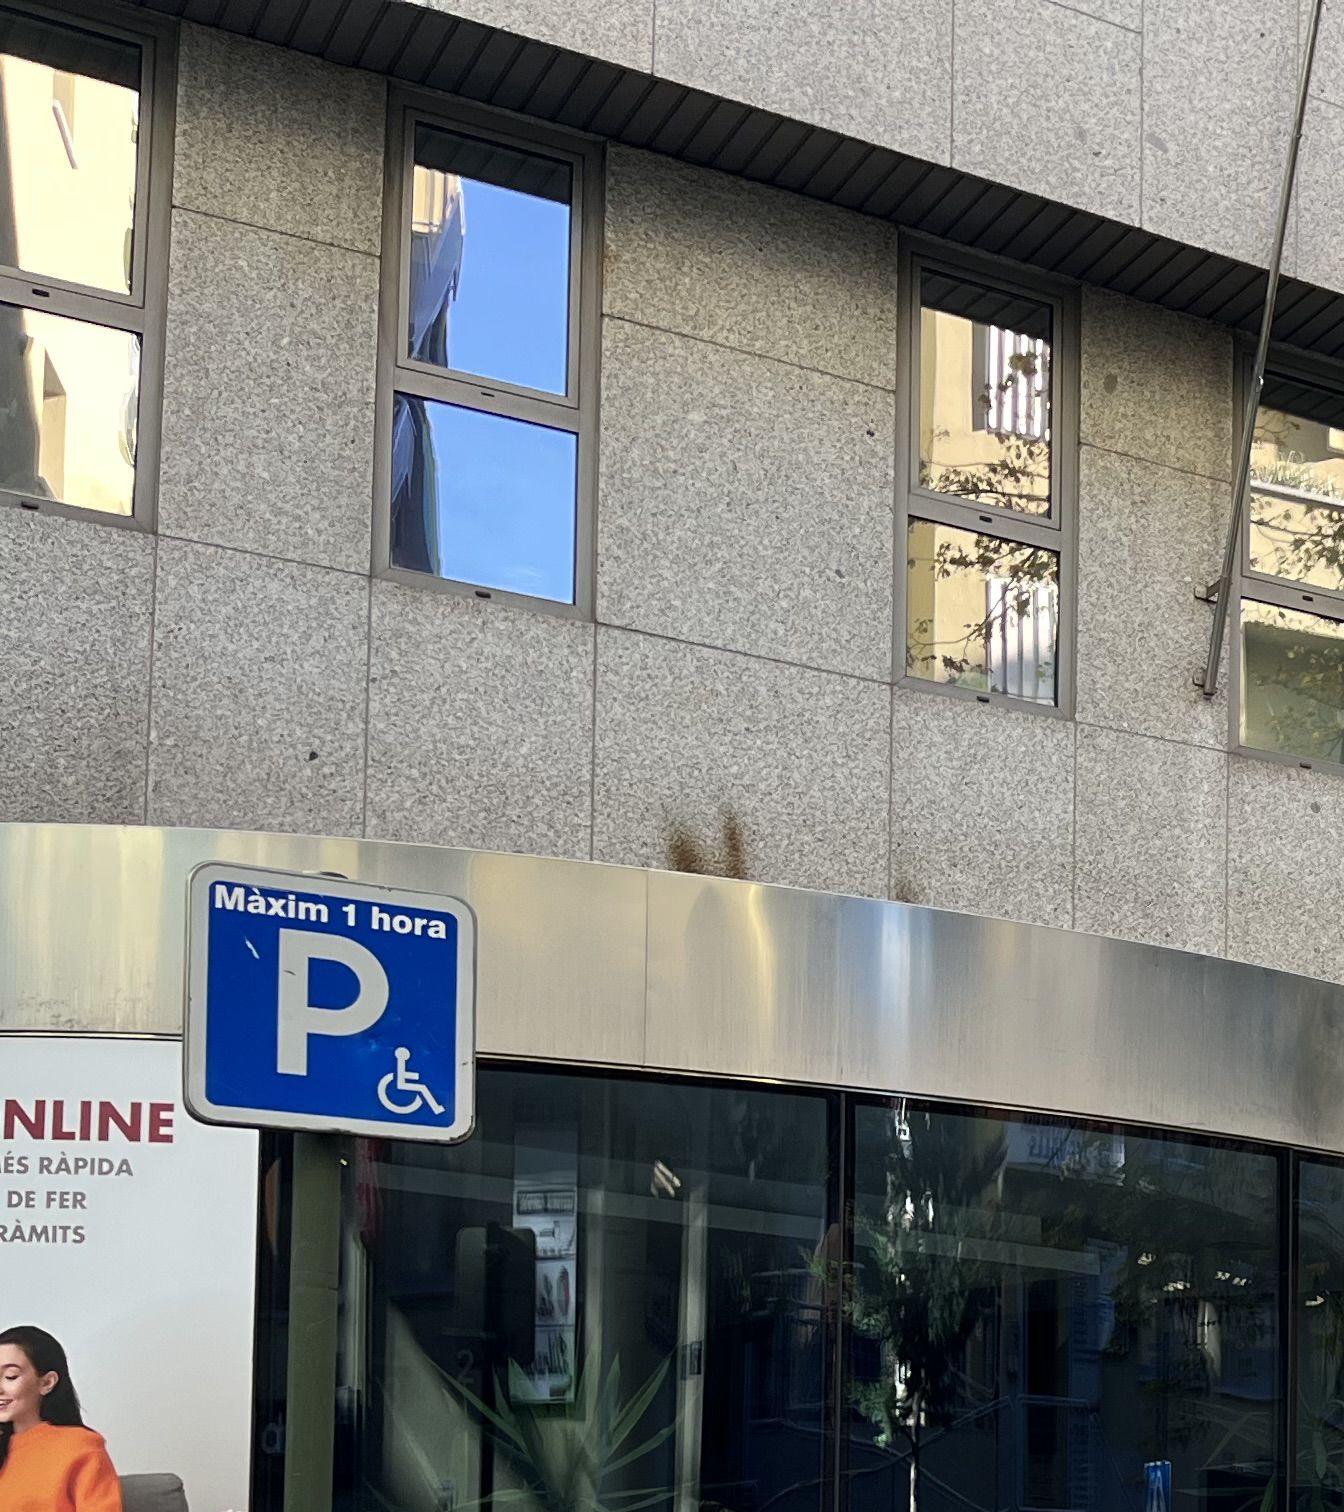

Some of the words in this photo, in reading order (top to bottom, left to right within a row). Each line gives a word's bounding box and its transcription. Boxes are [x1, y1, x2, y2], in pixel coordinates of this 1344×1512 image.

[214, 884, 329, 923] Màxim
[342, 904, 356, 927] 1
[371, 906, 447, 940] hora
[277, 928, 390, 1076] P
[3, 1099, 175, 1143] NLINE
[0, 1151, 30, 1174] ÉS
[38, 1151, 134, 1176] RÀPIDA
[7, 1190, 36, 1208] DE
[46, 1191, 87, 1209] FER
